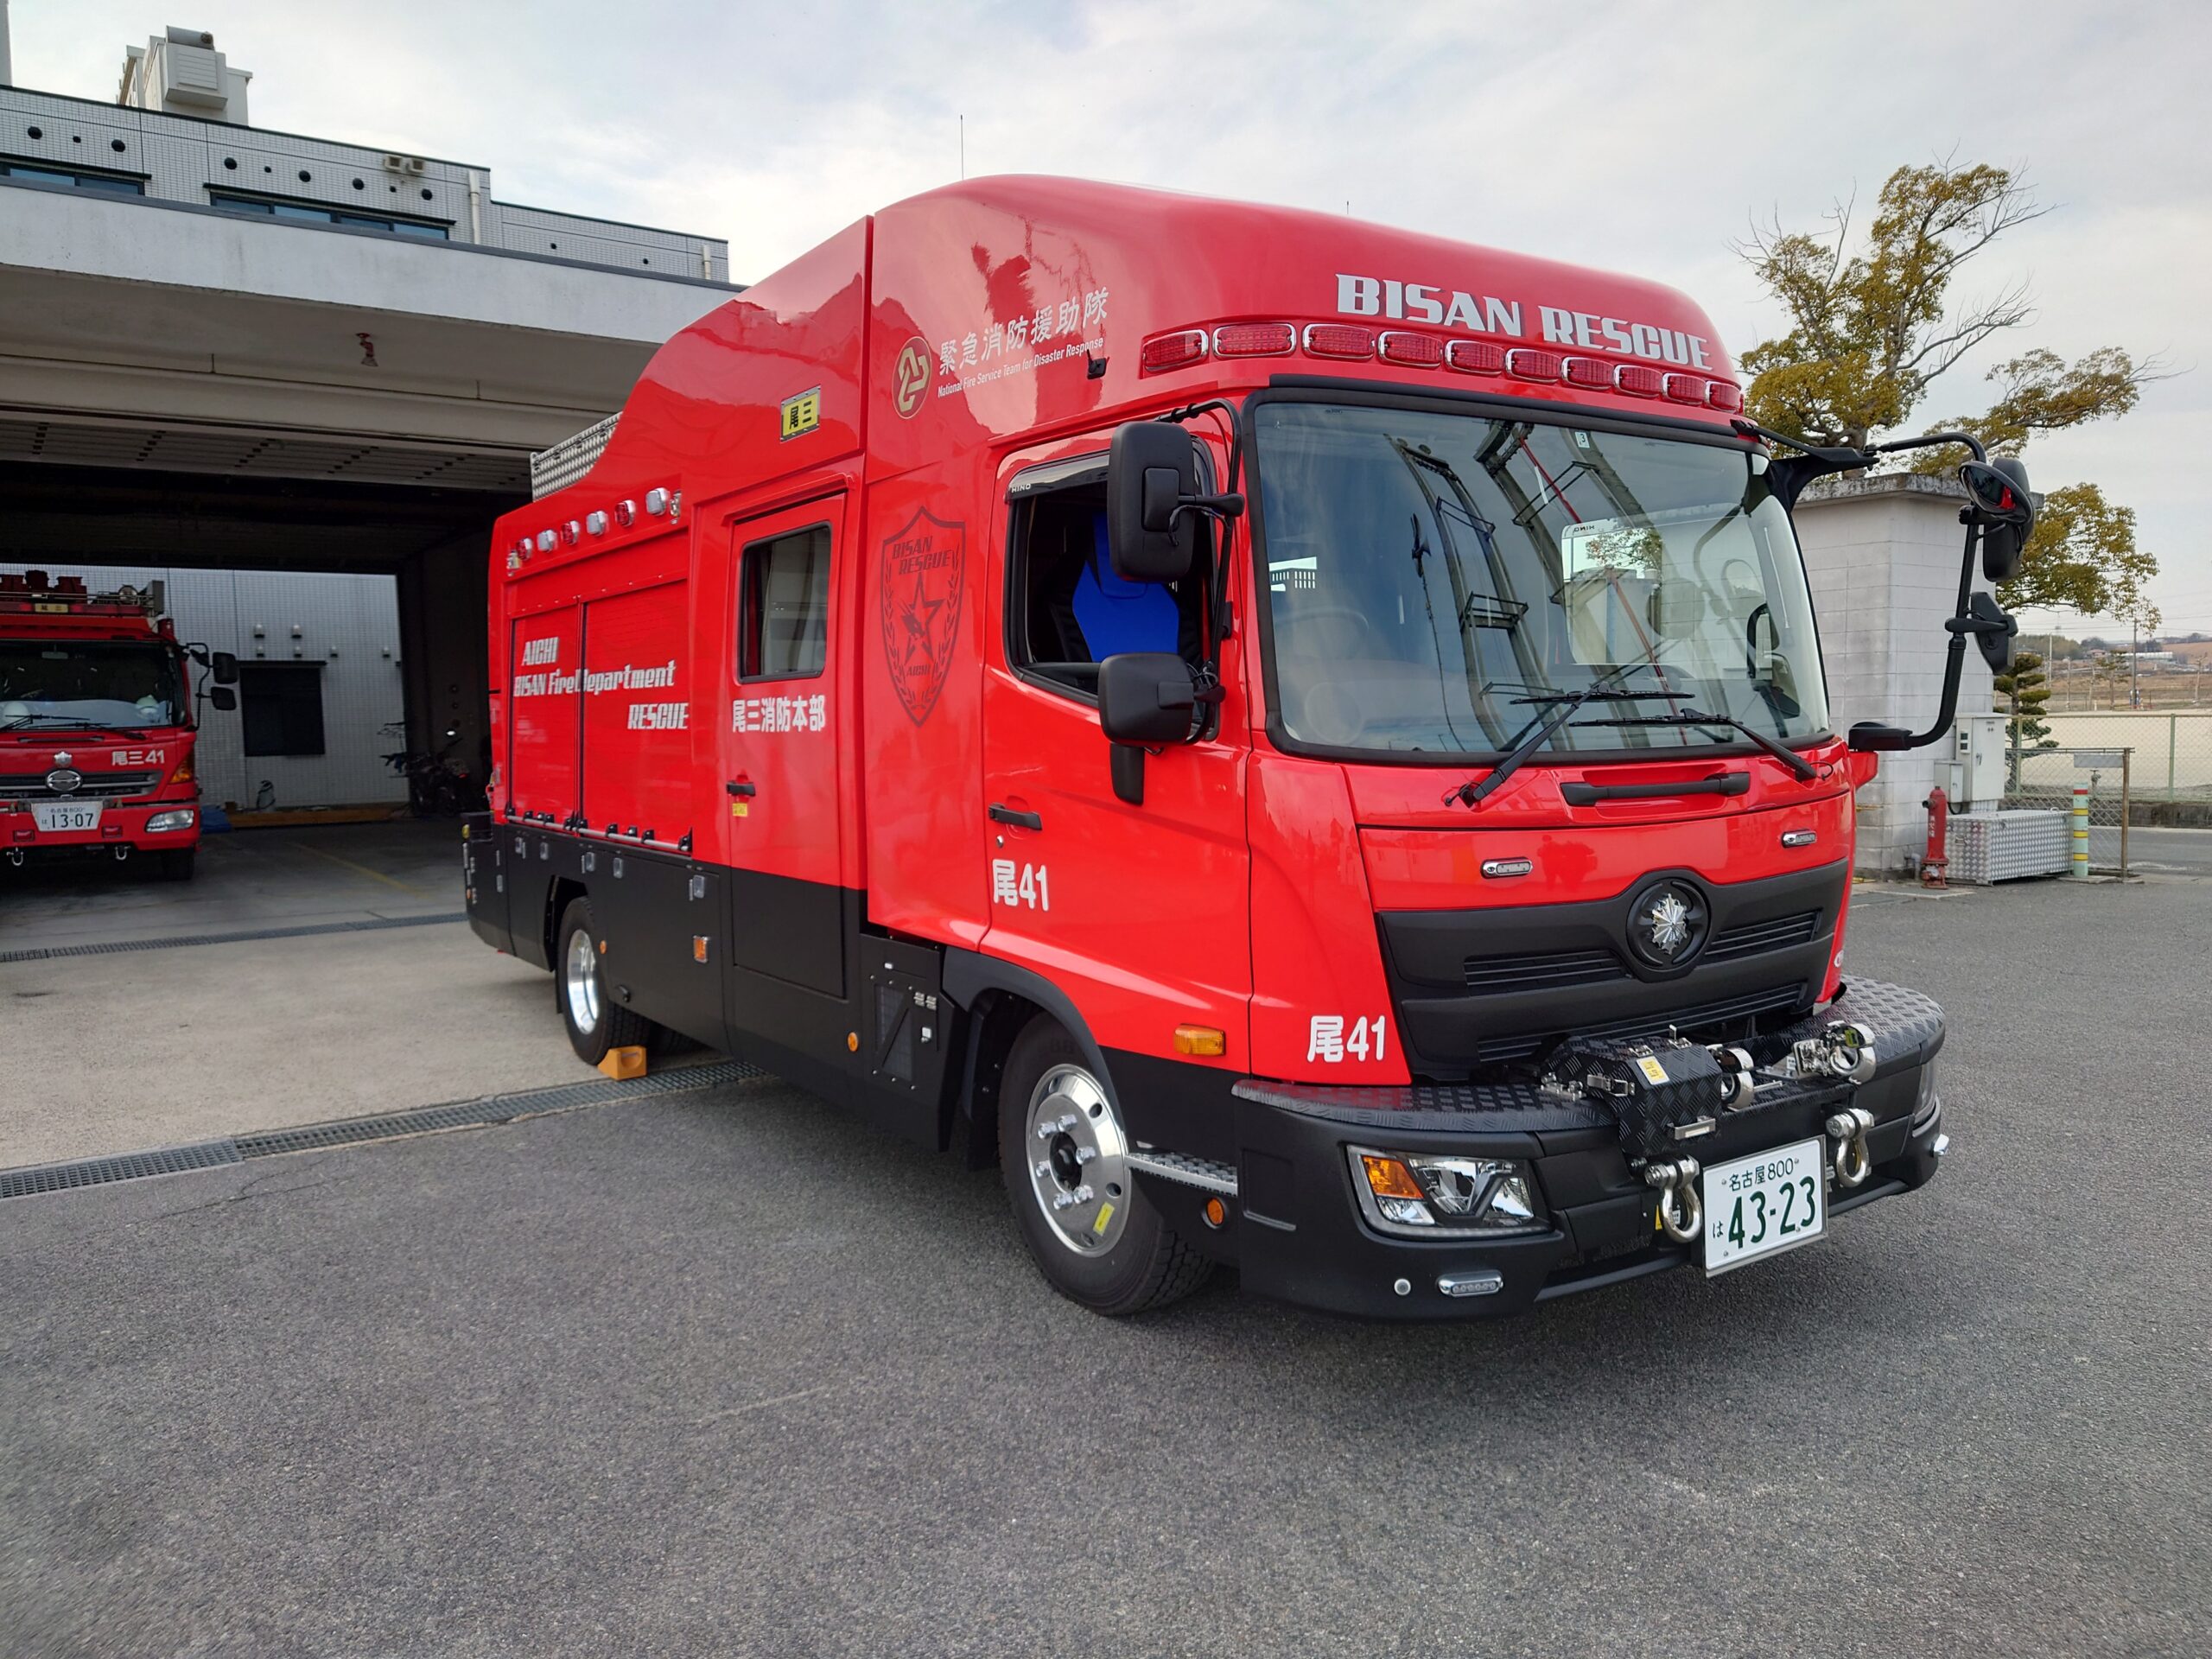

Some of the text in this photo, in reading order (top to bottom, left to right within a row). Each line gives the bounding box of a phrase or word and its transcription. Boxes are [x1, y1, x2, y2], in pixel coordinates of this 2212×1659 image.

[939, 286, 1109, 376] 緊急消防援助隊
[1335, 274, 1714, 372] BISAN RESCUE
[938, 337, 1104, 398] National Fire Service Team for Disaster Response
[789, 400, 812, 430] 尾三
[1011, 483, 1031, 493] HINO
[892, 535, 933, 560] BISAN
[899, 550, 950, 575] RESCUE
[521, 636, 559, 666] AICHI
[512, 673, 548, 697] BISAN
[547, 668, 575, 696] Fire
[626, 702, 690, 730] RESCUE
[732, 694, 826, 733] 尾三消防本部
[111, 749, 165, 766] 尾三41
[52, 813, 94, 829] 13-07
[992, 858, 1050, 912] 尾41
[1306, 1015, 1386, 1063] 尾41
[1712, 1175, 1816, 1249] は 43-23
